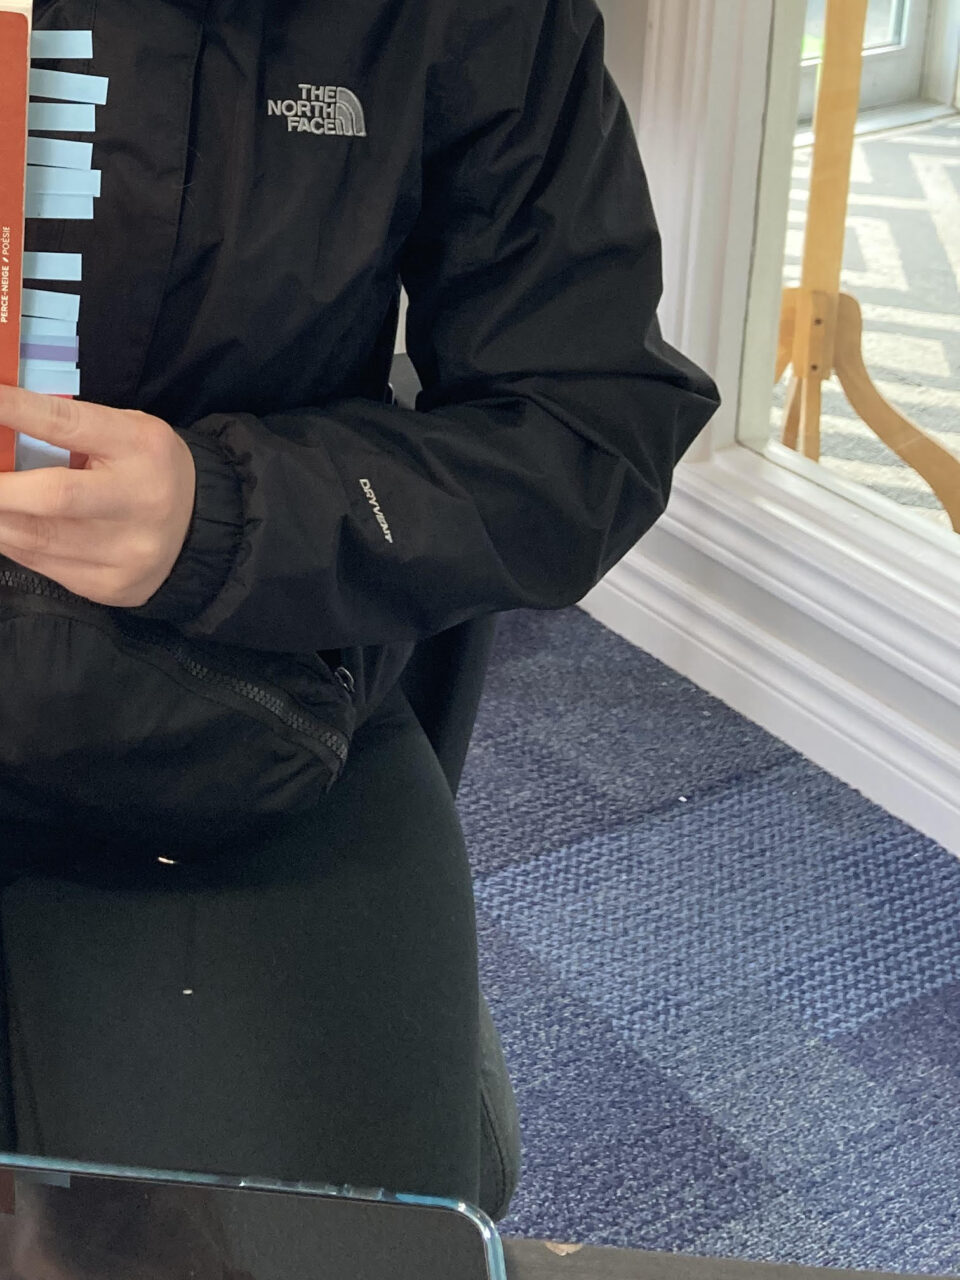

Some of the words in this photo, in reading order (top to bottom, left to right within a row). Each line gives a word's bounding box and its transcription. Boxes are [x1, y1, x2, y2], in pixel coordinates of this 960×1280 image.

[298, 83, 337, 103] THE
[267, 99, 336, 119] NORTH
[287, 116, 336, 135] FACE
[0, 225, 10, 256] POÉSIE
[0, 265, 10, 324] PERCE-NEIGE
[359, 478, 394, 544] DRYVENT
